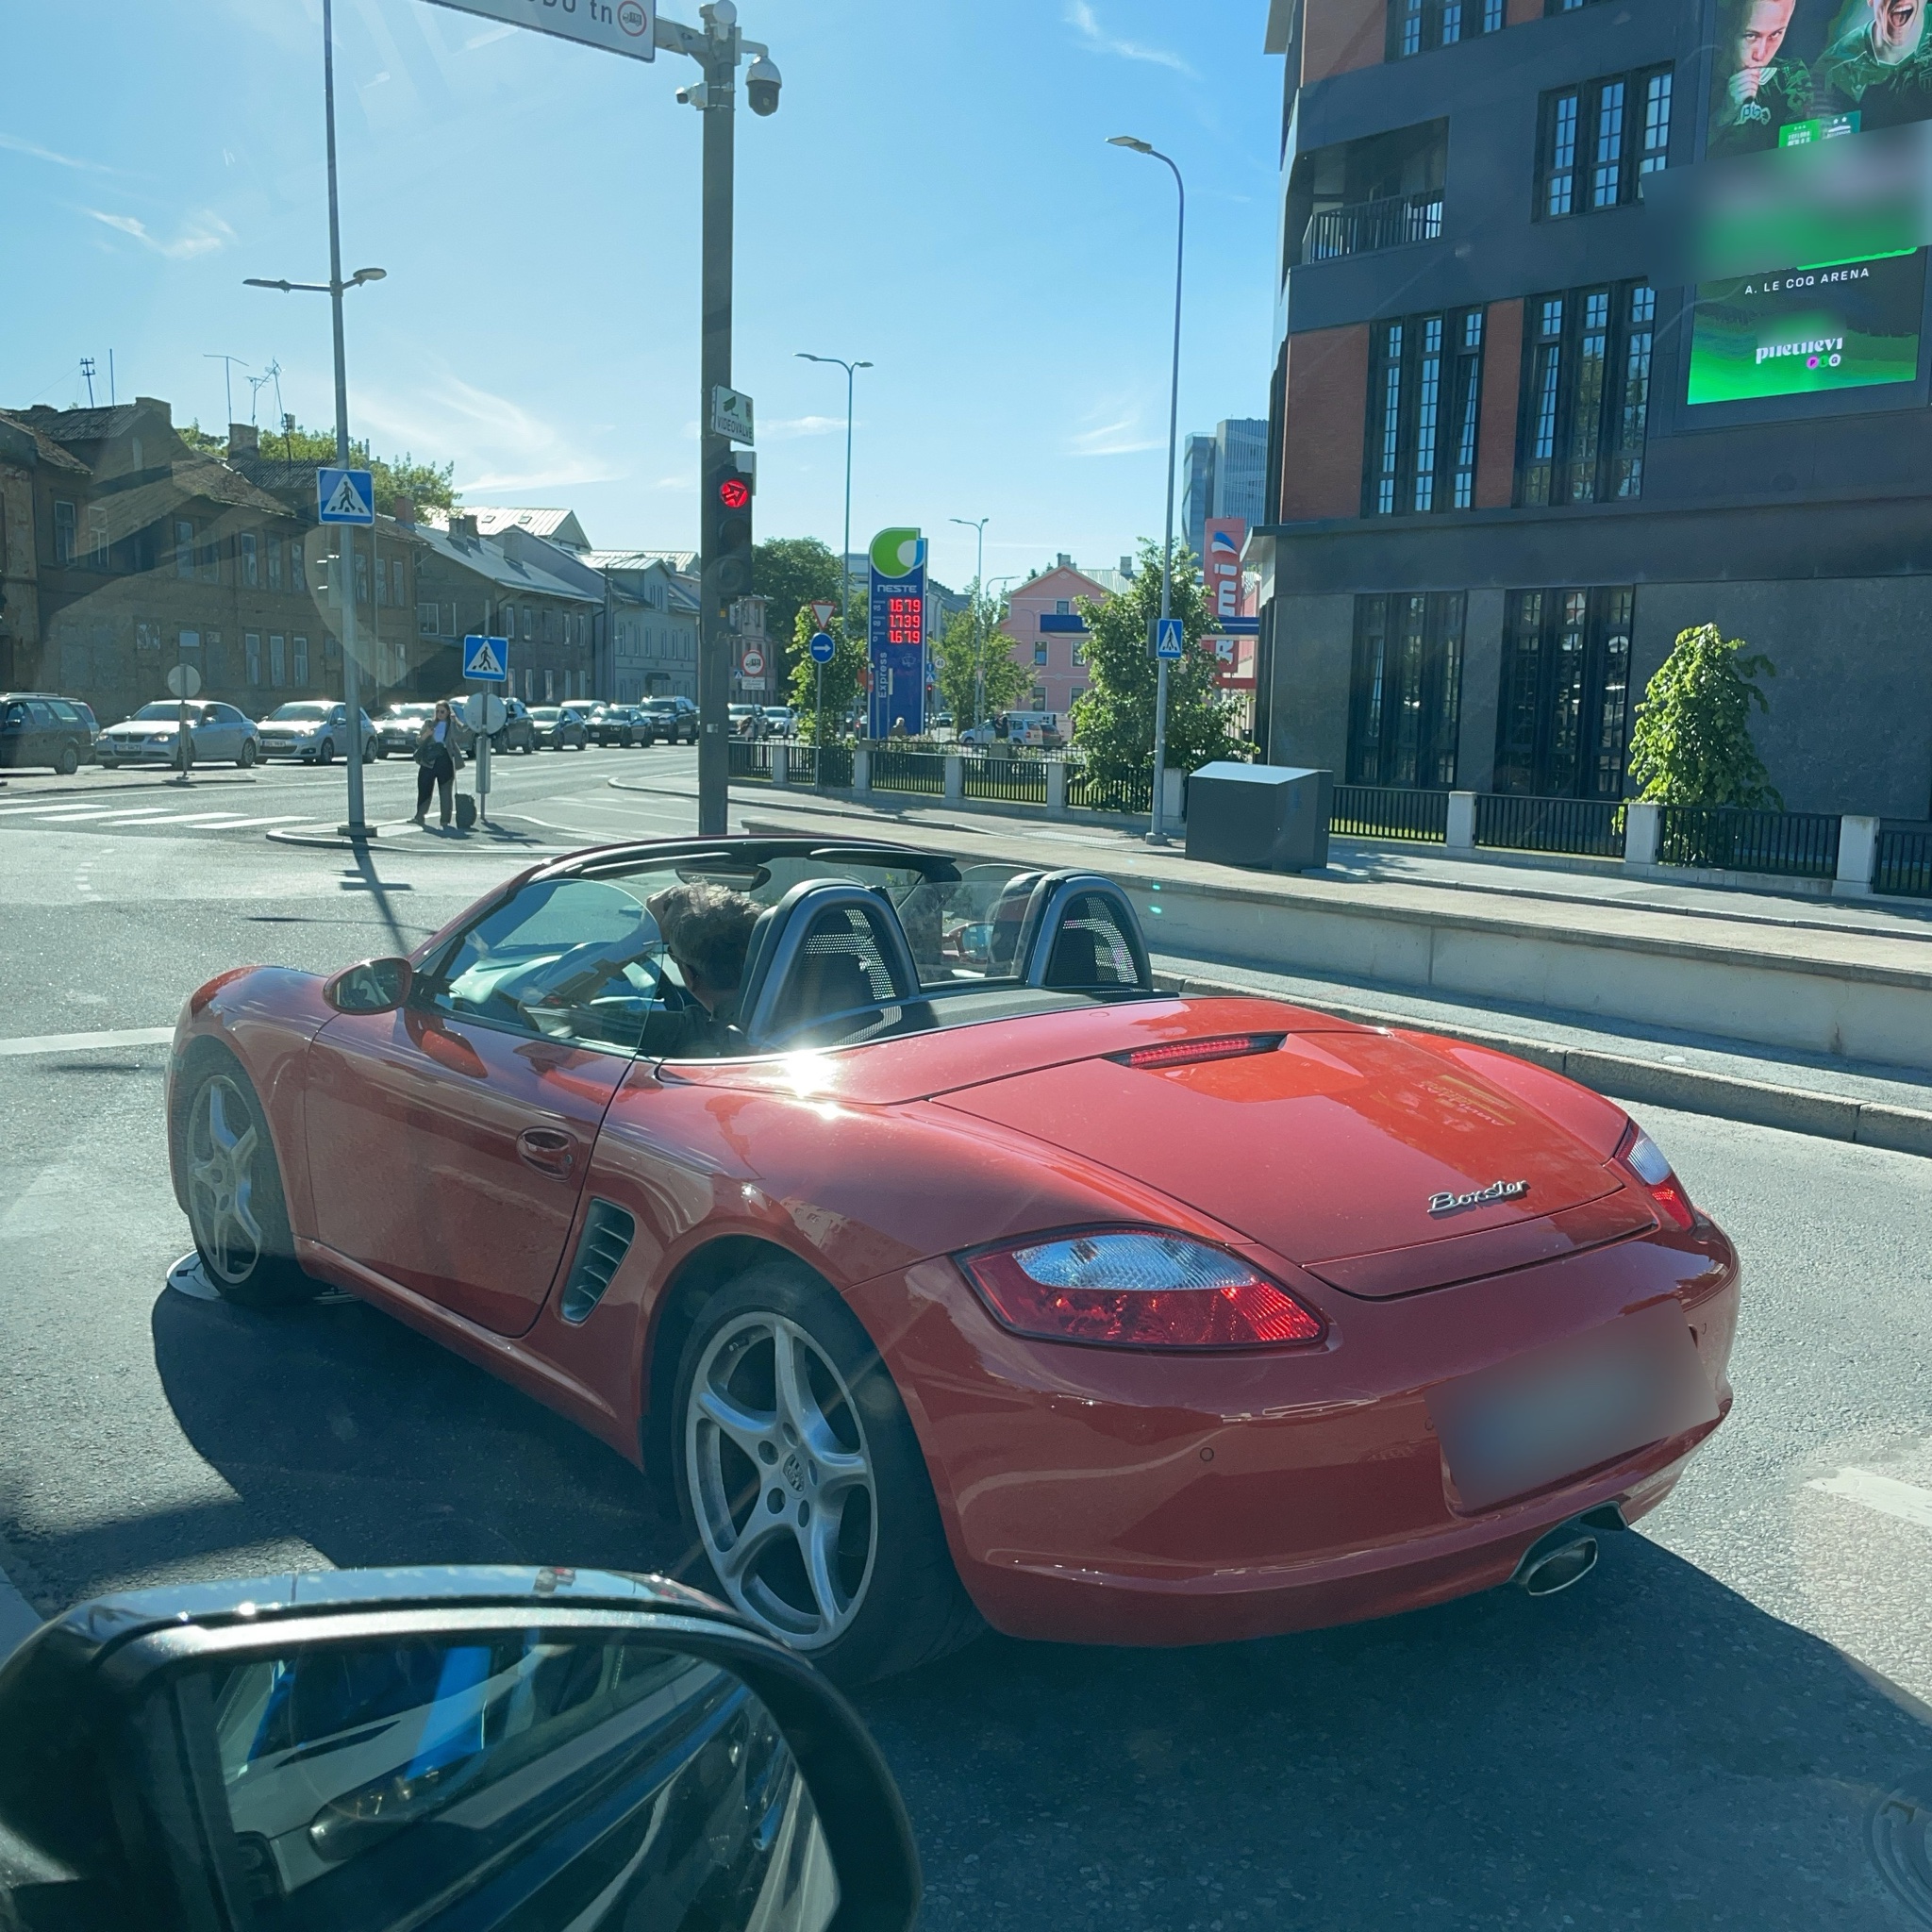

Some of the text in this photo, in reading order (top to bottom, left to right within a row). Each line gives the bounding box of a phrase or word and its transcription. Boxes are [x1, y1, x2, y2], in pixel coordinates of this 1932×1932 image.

[1744, 267, 1870, 294] A. LE COQ ARENA
[877, 584, 918, 592] NESTE
[1213, 563, 1238, 664] Rmi
[879, 652, 888, 698] Express
[1426, 1180, 1526, 1213] Boxster
